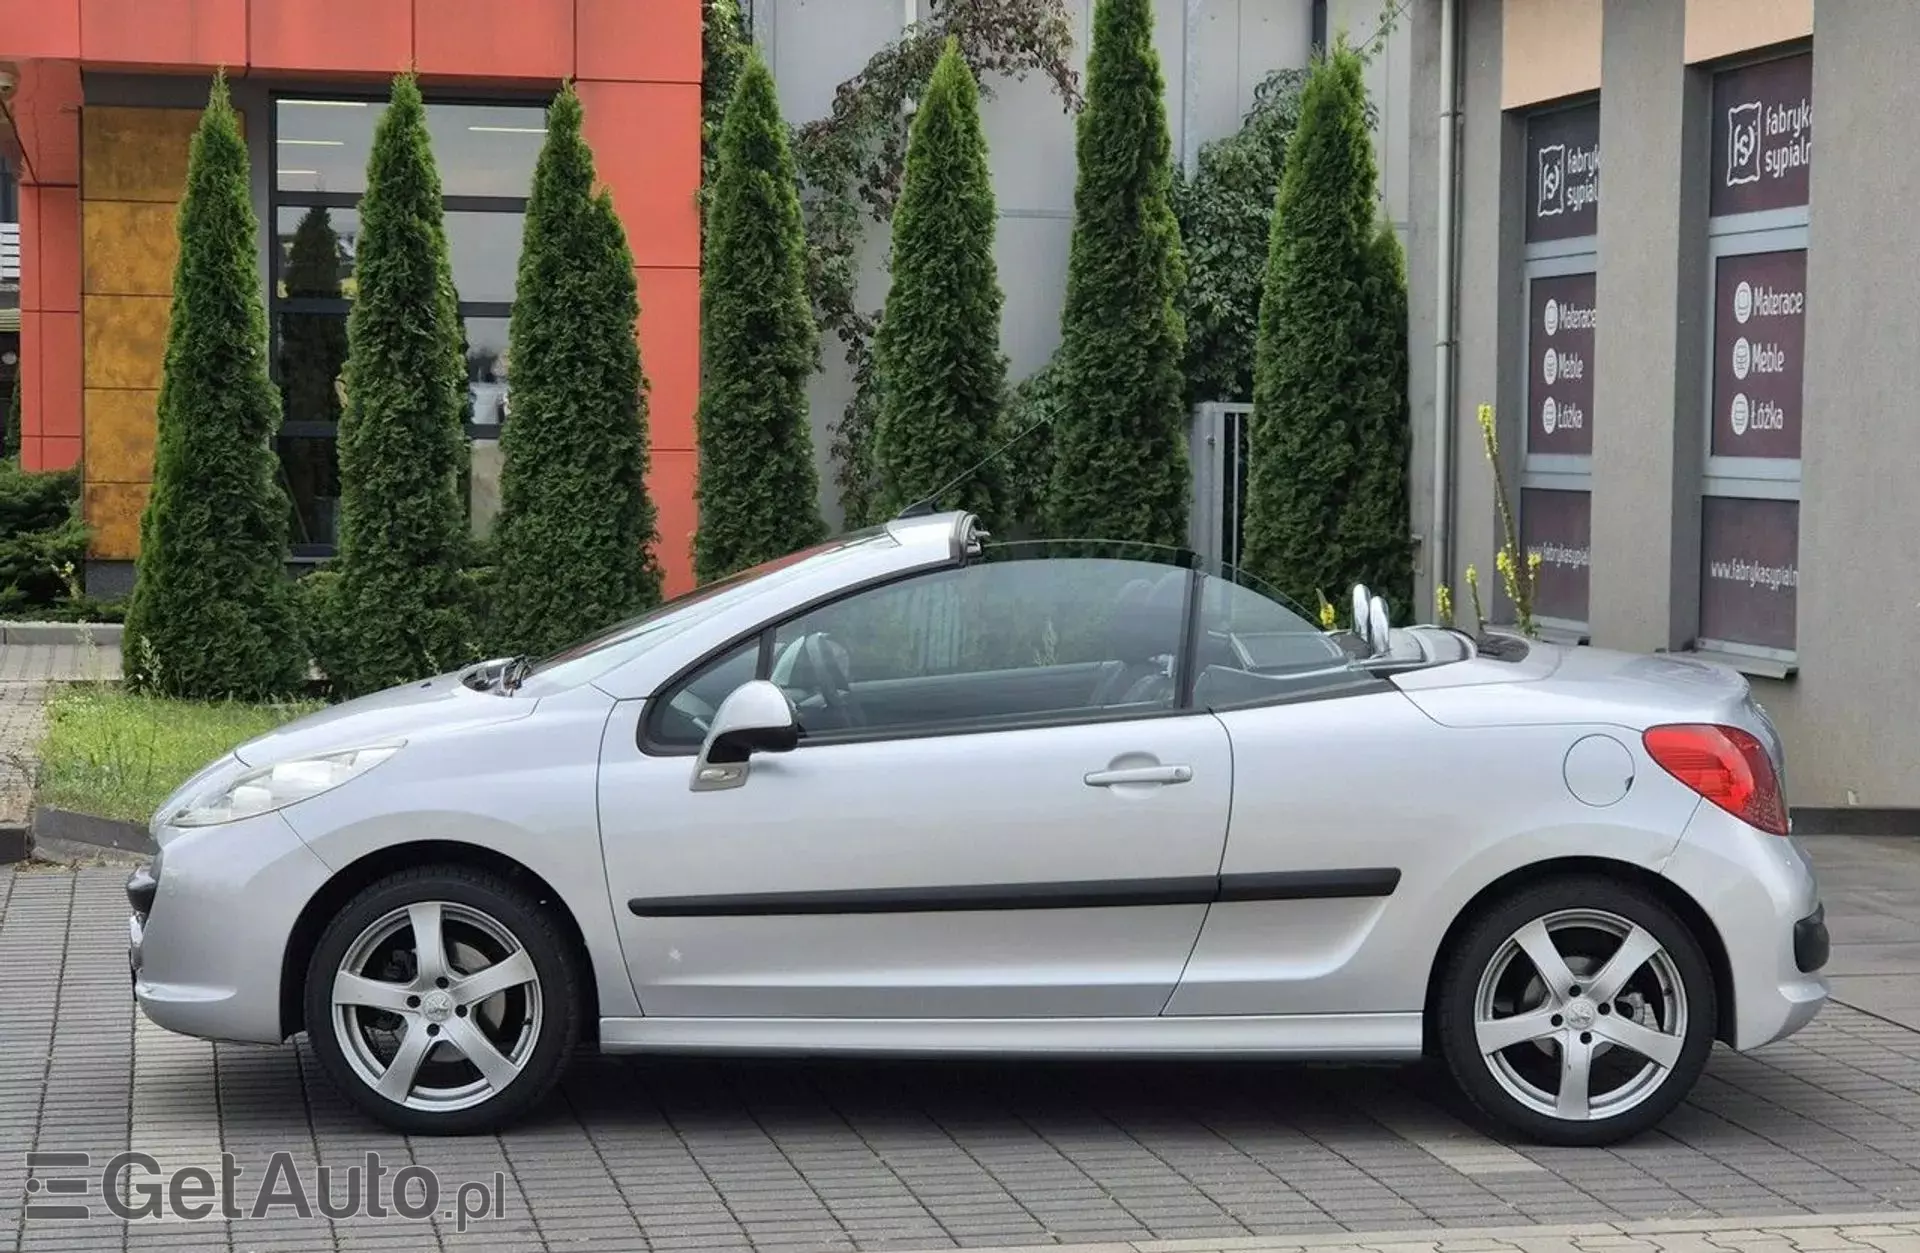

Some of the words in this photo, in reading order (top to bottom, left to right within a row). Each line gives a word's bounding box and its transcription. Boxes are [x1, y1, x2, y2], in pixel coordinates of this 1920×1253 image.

[1753, 285, 1803, 316] Materace
[1559, 302, 1597, 330] Materace
[1558, 351, 1584, 379] Meble
[1751, 342, 1785, 373] Meble
[1558, 402, 1583, 428] Łóżka
[1750, 399, 1784, 430] Łóżka
